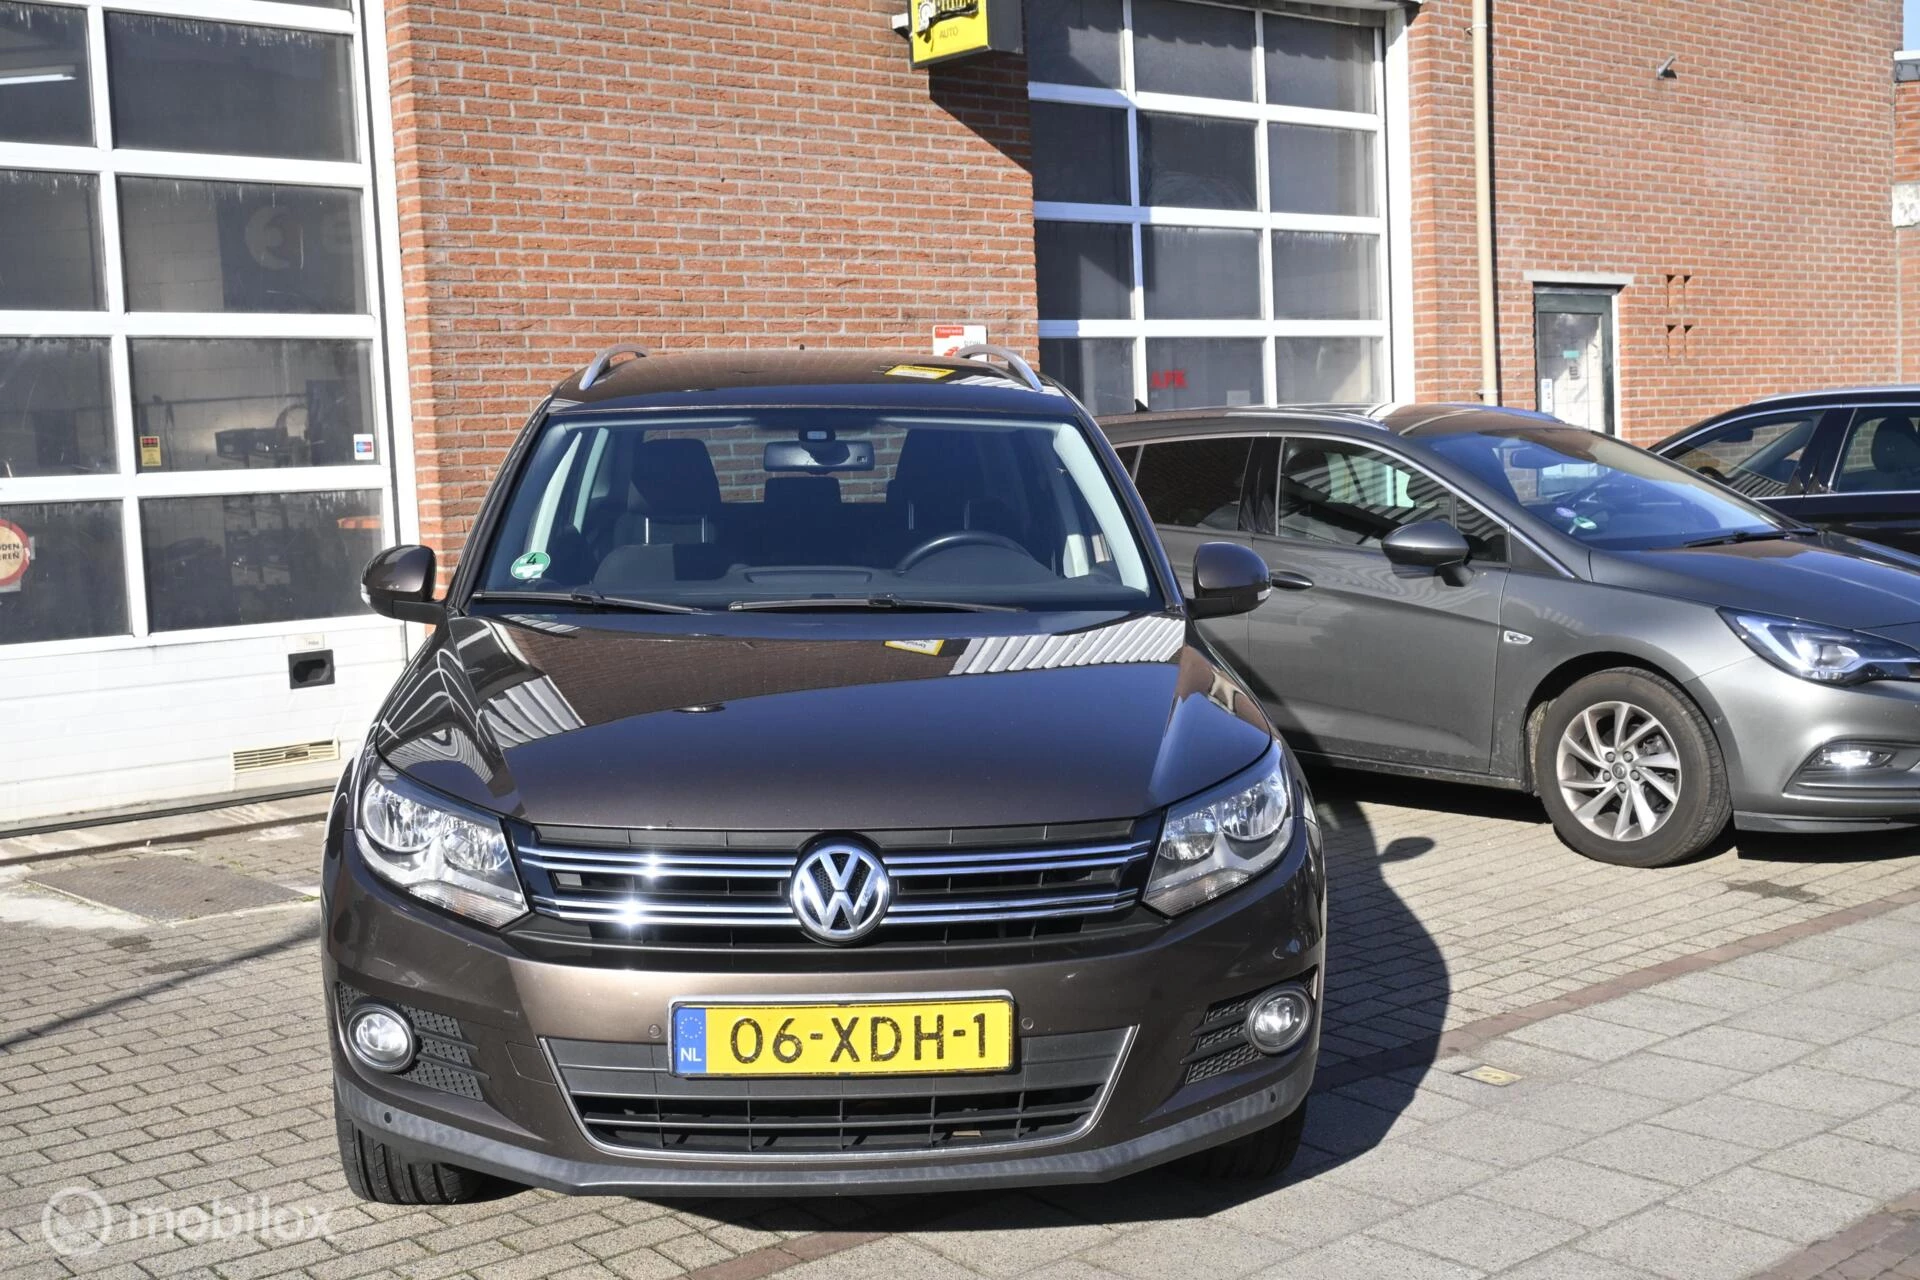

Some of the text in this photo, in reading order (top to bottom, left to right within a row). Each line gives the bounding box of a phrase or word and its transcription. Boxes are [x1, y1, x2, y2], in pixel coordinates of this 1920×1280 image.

[939, 26, 959, 40] AUTO
[1151, 370, 1188, 389] APK
[0, 543, 20, 551] DEN
[0, 552, 20, 560] REN
[526, 553, 538, 565] 4
[729, 1013, 987, 1064] 06-XDH-1
[680, 1047, 702, 1062] NL
